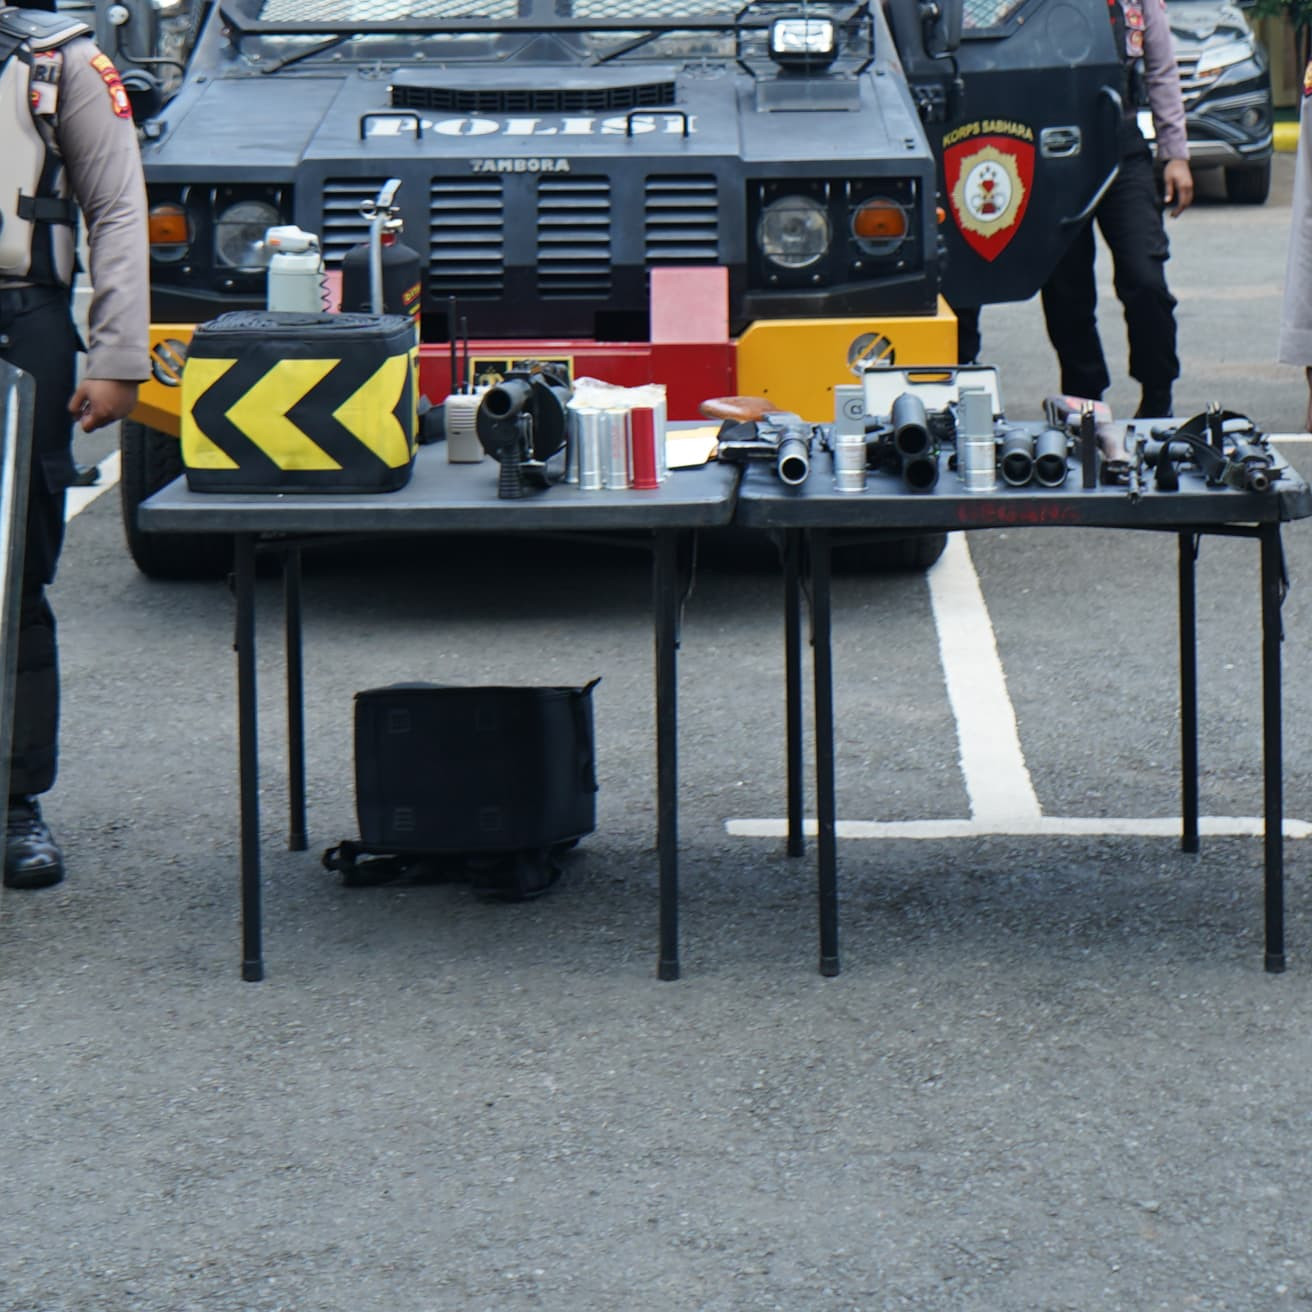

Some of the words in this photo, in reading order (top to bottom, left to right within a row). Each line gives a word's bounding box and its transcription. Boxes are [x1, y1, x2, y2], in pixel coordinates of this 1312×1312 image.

[366, 116, 698, 136] POLISI
[942, 121, 981, 148] KORPS
[981, 119, 1034, 142] SABHARA
[470, 158, 571, 172] TAMBORA
